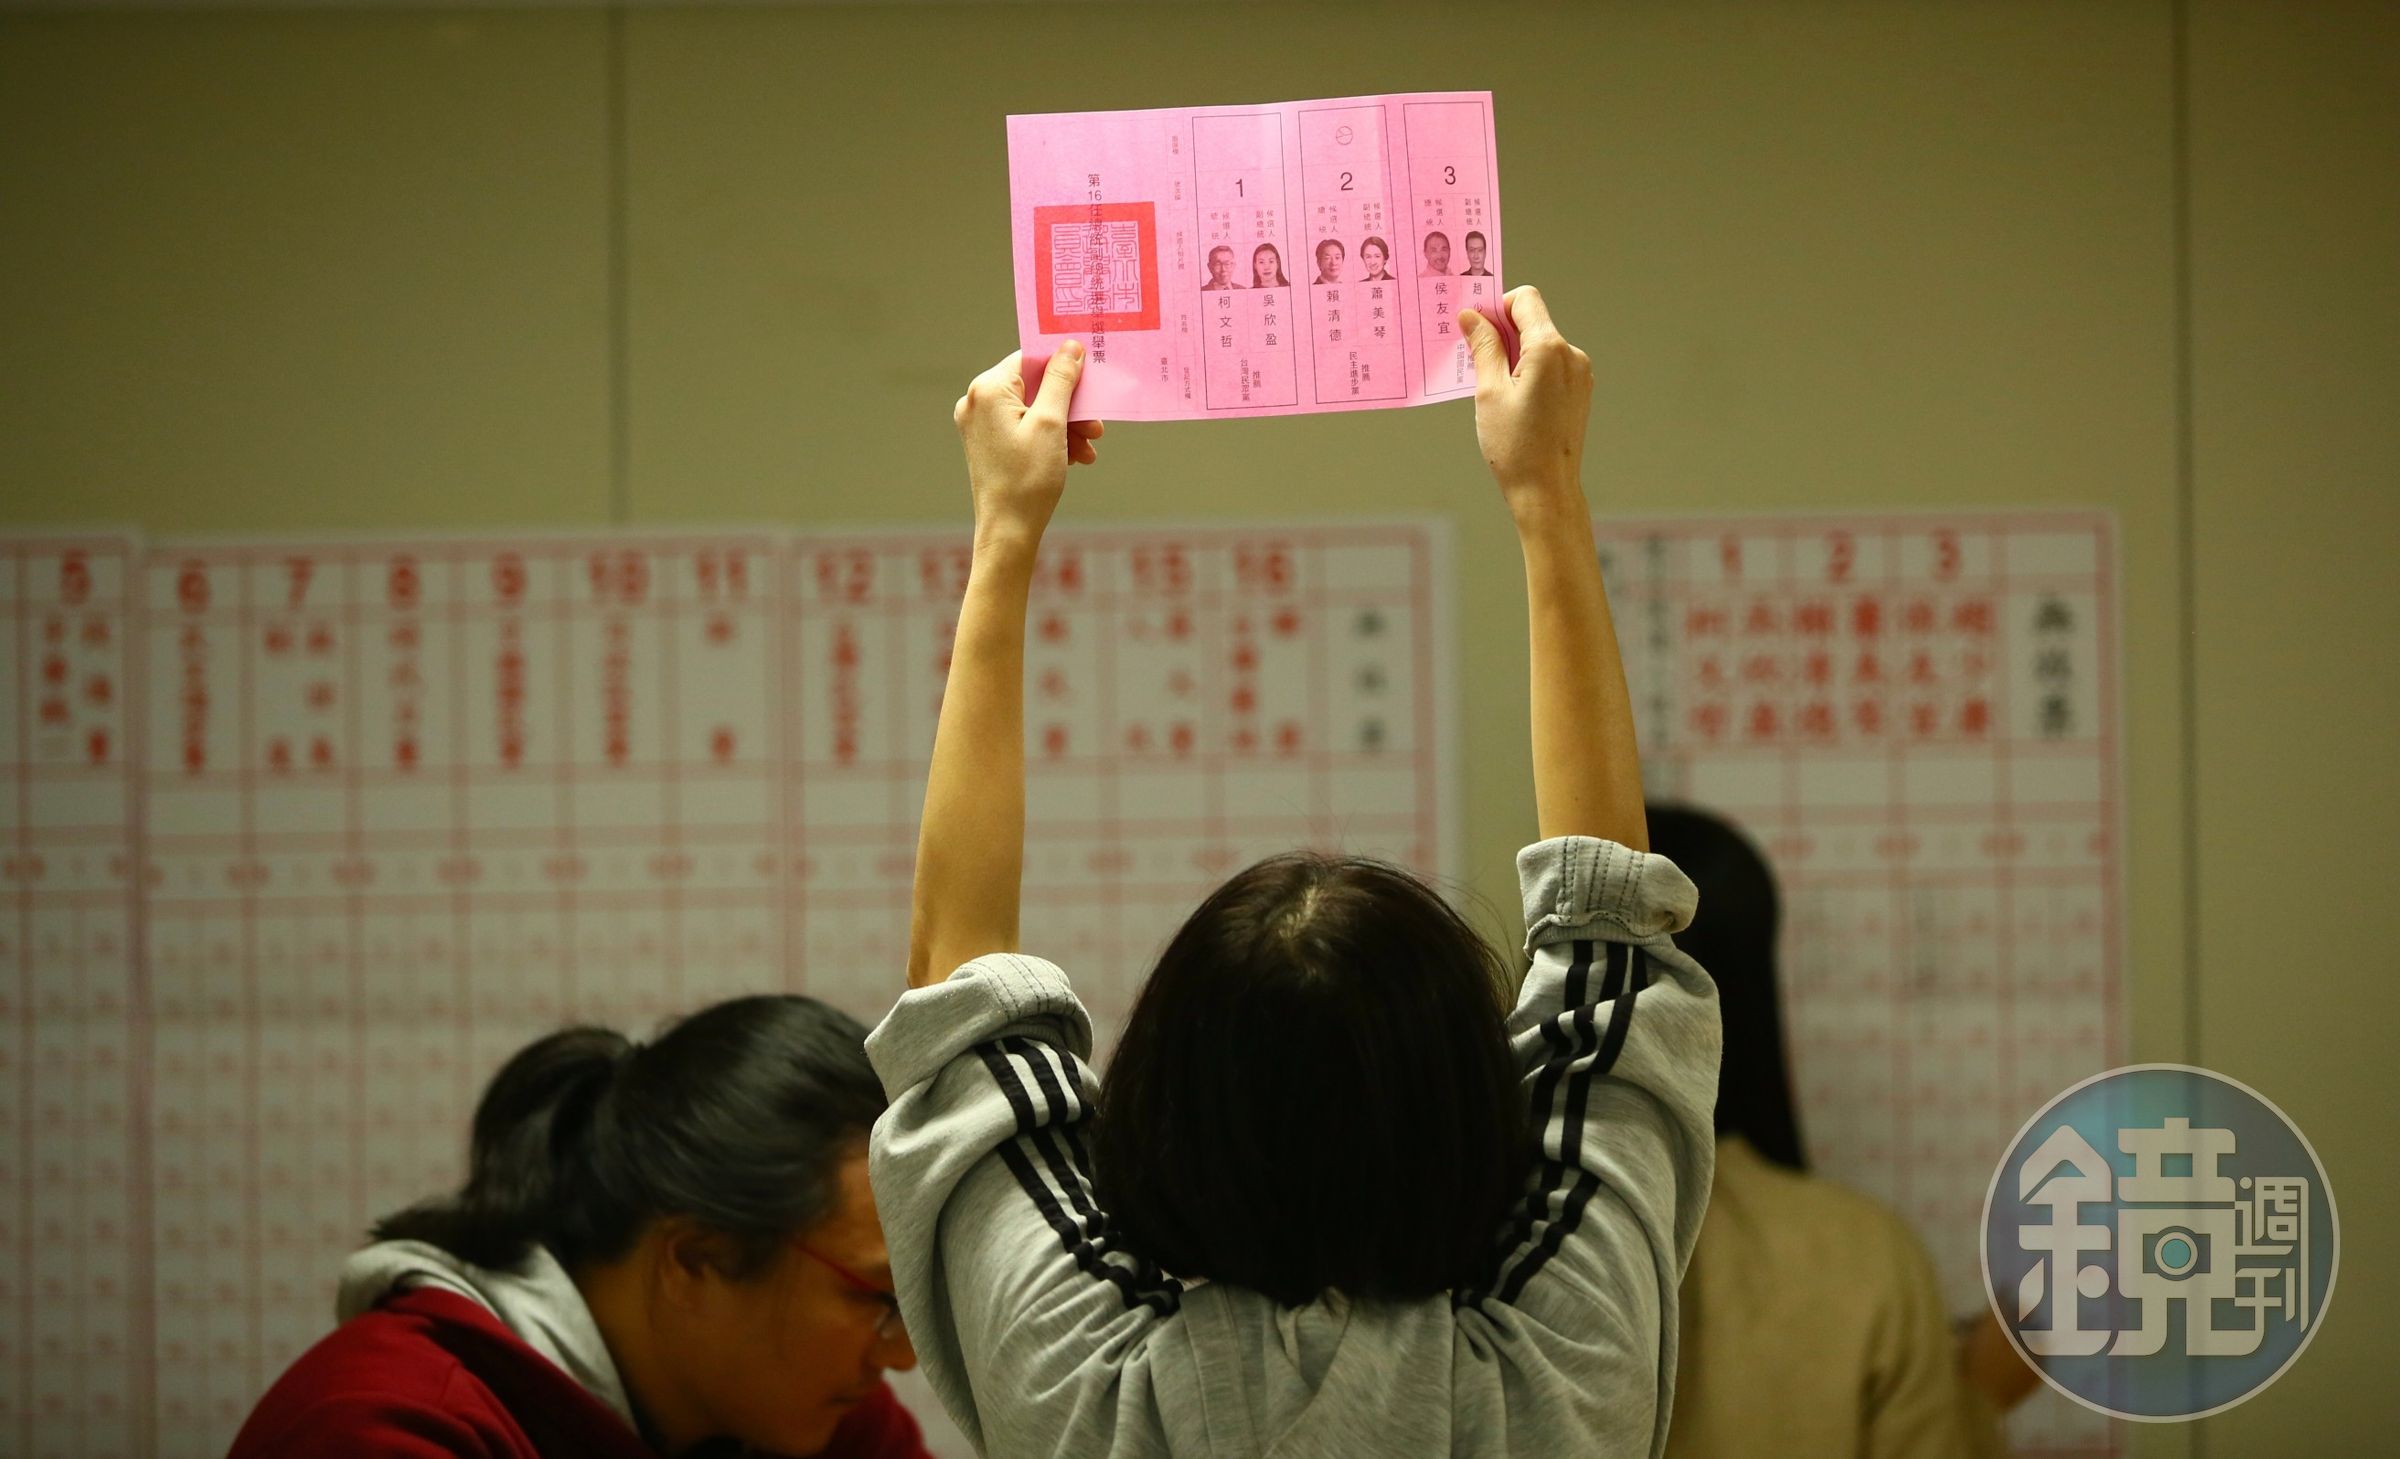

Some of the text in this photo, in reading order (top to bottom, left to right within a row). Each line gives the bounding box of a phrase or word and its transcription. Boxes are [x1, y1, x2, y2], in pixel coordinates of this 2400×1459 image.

[1235, 178, 1243, 197] 1
[1340, 172, 1354, 191] 2
[1444, 166, 1456, 185] 3
[1219, 296, 1232, 348] 柯文哲
[1263, 294, 1277, 346] 吳欣盈
[1327, 290, 1342, 341] 賴清德
[1371, 287, 1386, 338] 蕭美琴
[1435, 282, 1450, 335] 侯友宜
[1349, 352, 1360, 395] 民主進步黨
[61, 549, 91, 606] 5
[588, 547, 649, 606] 10
[695, 547, 748, 602] 11
[814, 547, 873, 605] 12
[1826, 529, 1857, 584] 2
[1932, 527, 1961, 583] 3
[286, 555, 313, 610] 7
